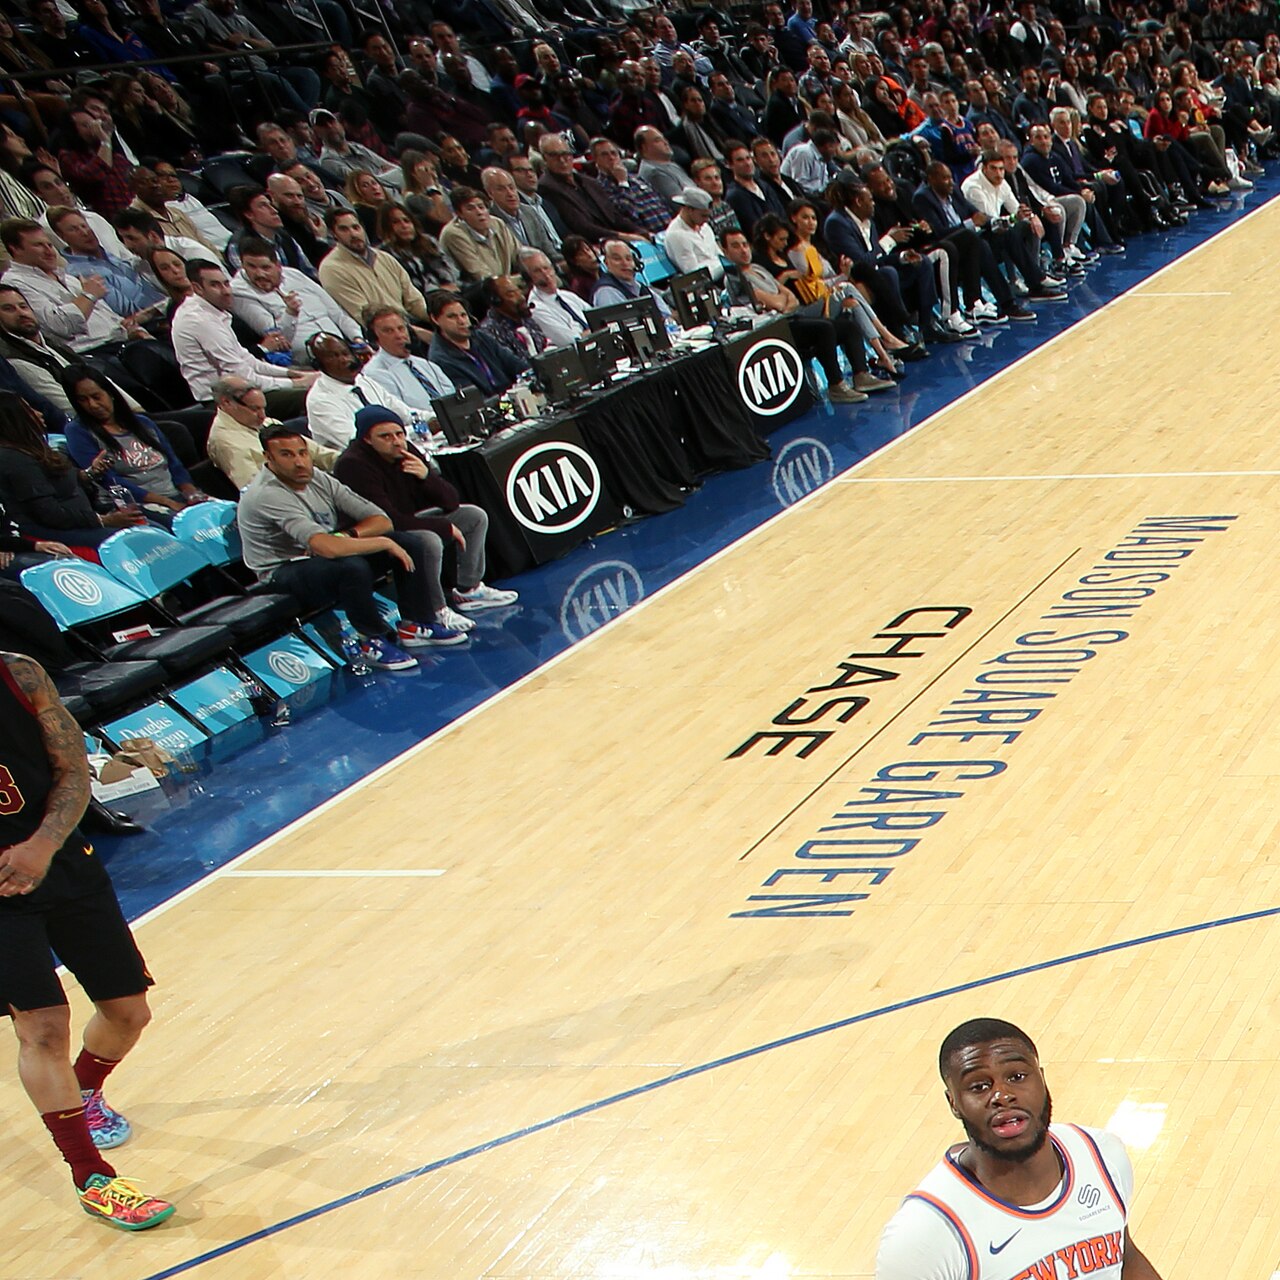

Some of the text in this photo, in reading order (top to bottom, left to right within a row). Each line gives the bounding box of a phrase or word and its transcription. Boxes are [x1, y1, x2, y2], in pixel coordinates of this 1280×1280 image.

[746, 350, 796, 406] KIA
[516, 456, 593, 523] KIA
[724, 606, 973, 760] CHASE
[727, 515, 1239, 918] MADISON SQUARE GARDEN
[1055, 1229, 1122, 1280] YORK
